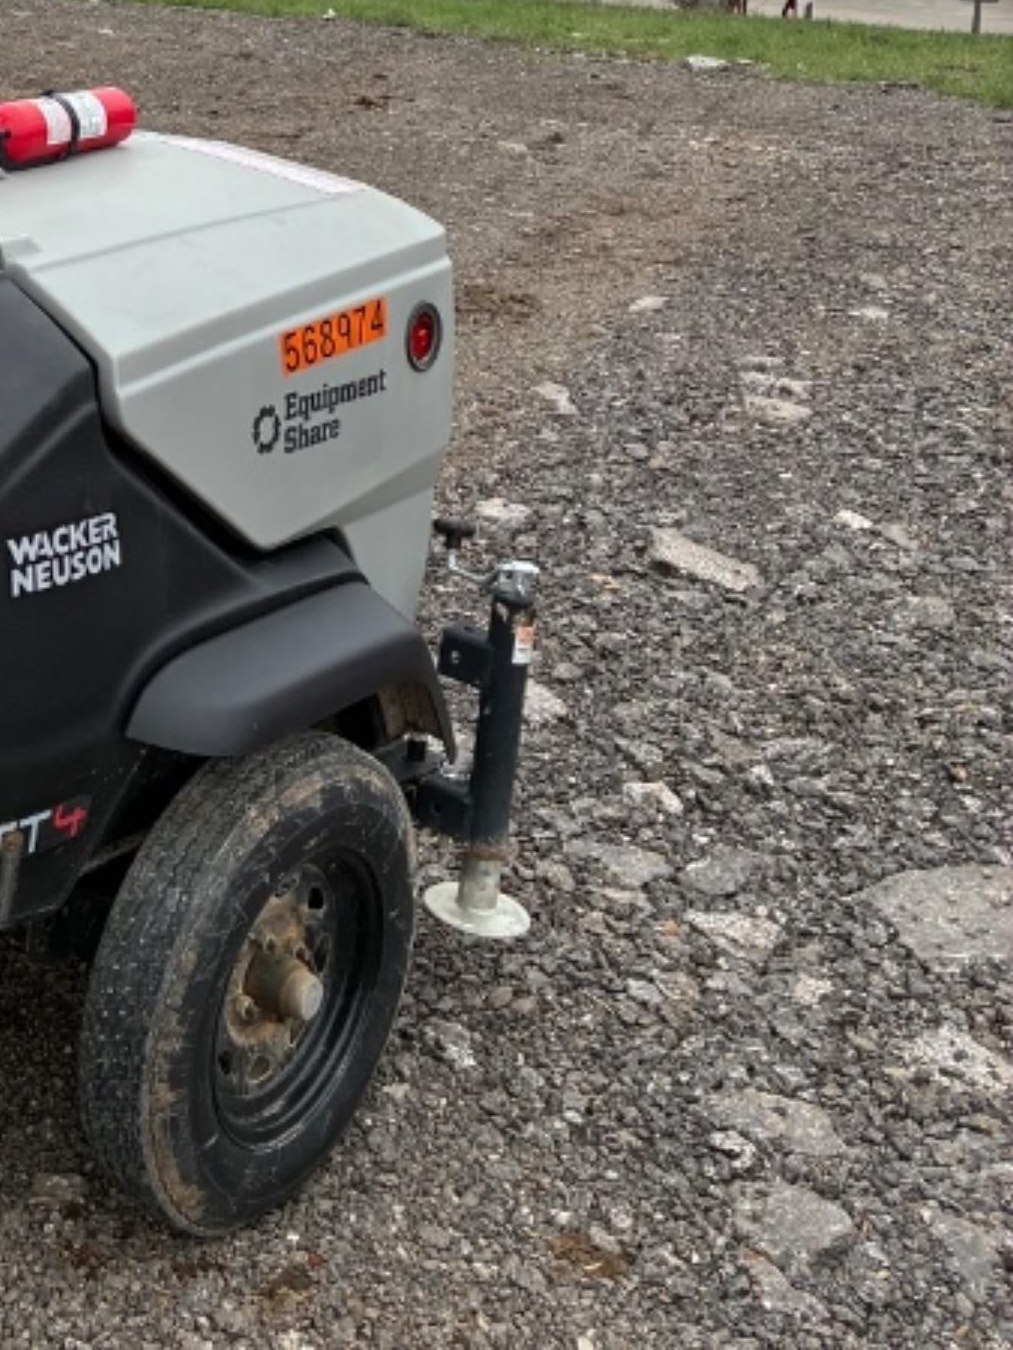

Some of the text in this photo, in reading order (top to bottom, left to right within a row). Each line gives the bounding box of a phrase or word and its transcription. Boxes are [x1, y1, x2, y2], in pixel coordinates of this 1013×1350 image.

[282, 299, 384, 372] 568974
[284, 368, 387, 421] Equipment
[284, 418, 341, 454] Share
[7, 512, 118, 565] WACKER
[11, 538, 121, 598] NEUSON
